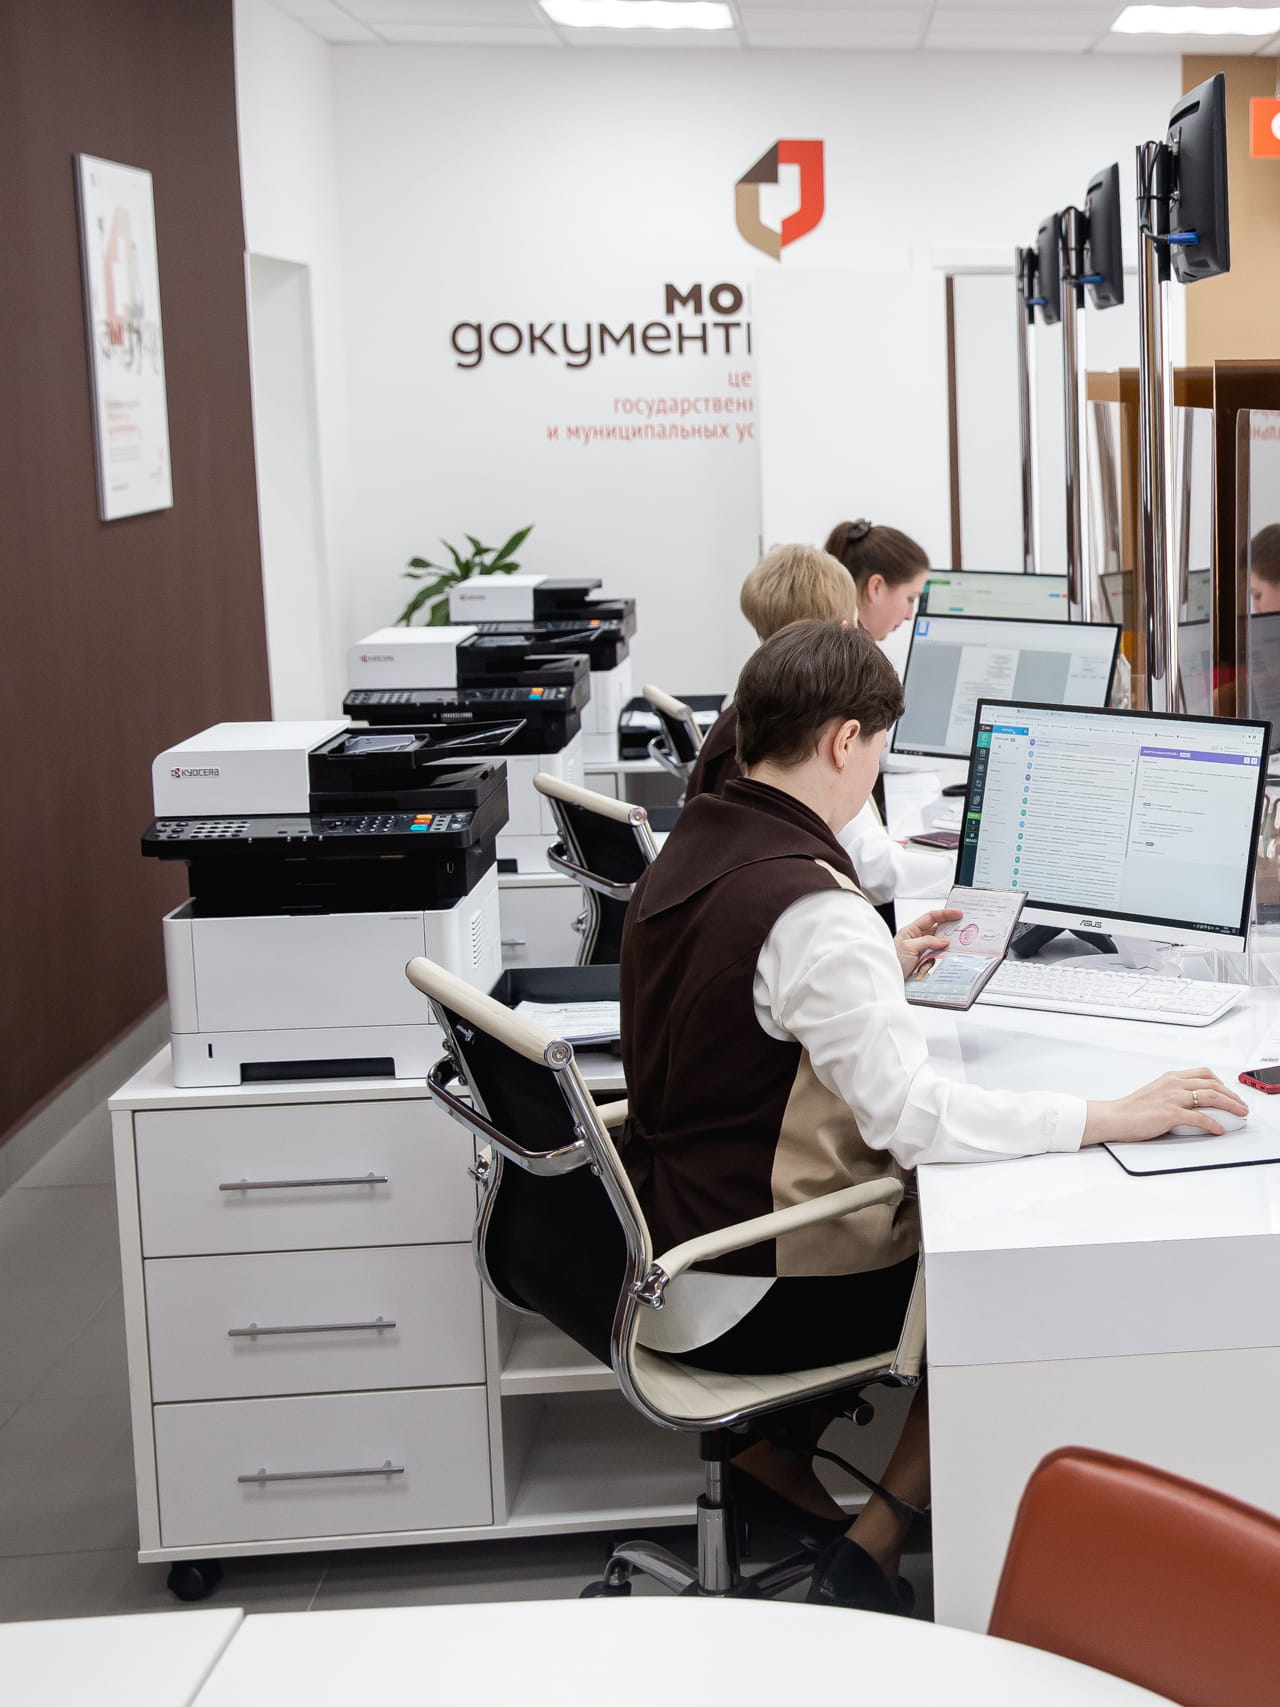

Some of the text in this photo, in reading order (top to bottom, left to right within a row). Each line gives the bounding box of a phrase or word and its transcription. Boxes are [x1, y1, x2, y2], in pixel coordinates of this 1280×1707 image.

[665, 283, 750, 315] мо
[452, 322, 751, 368] документ
[613, 397, 753, 417] государствен
[547, 424, 558, 440] и
[566, 422, 729, 445] муниципальных
[181, 768, 220, 777] KYOCERA
[1080, 919, 1103, 929] ASUS
